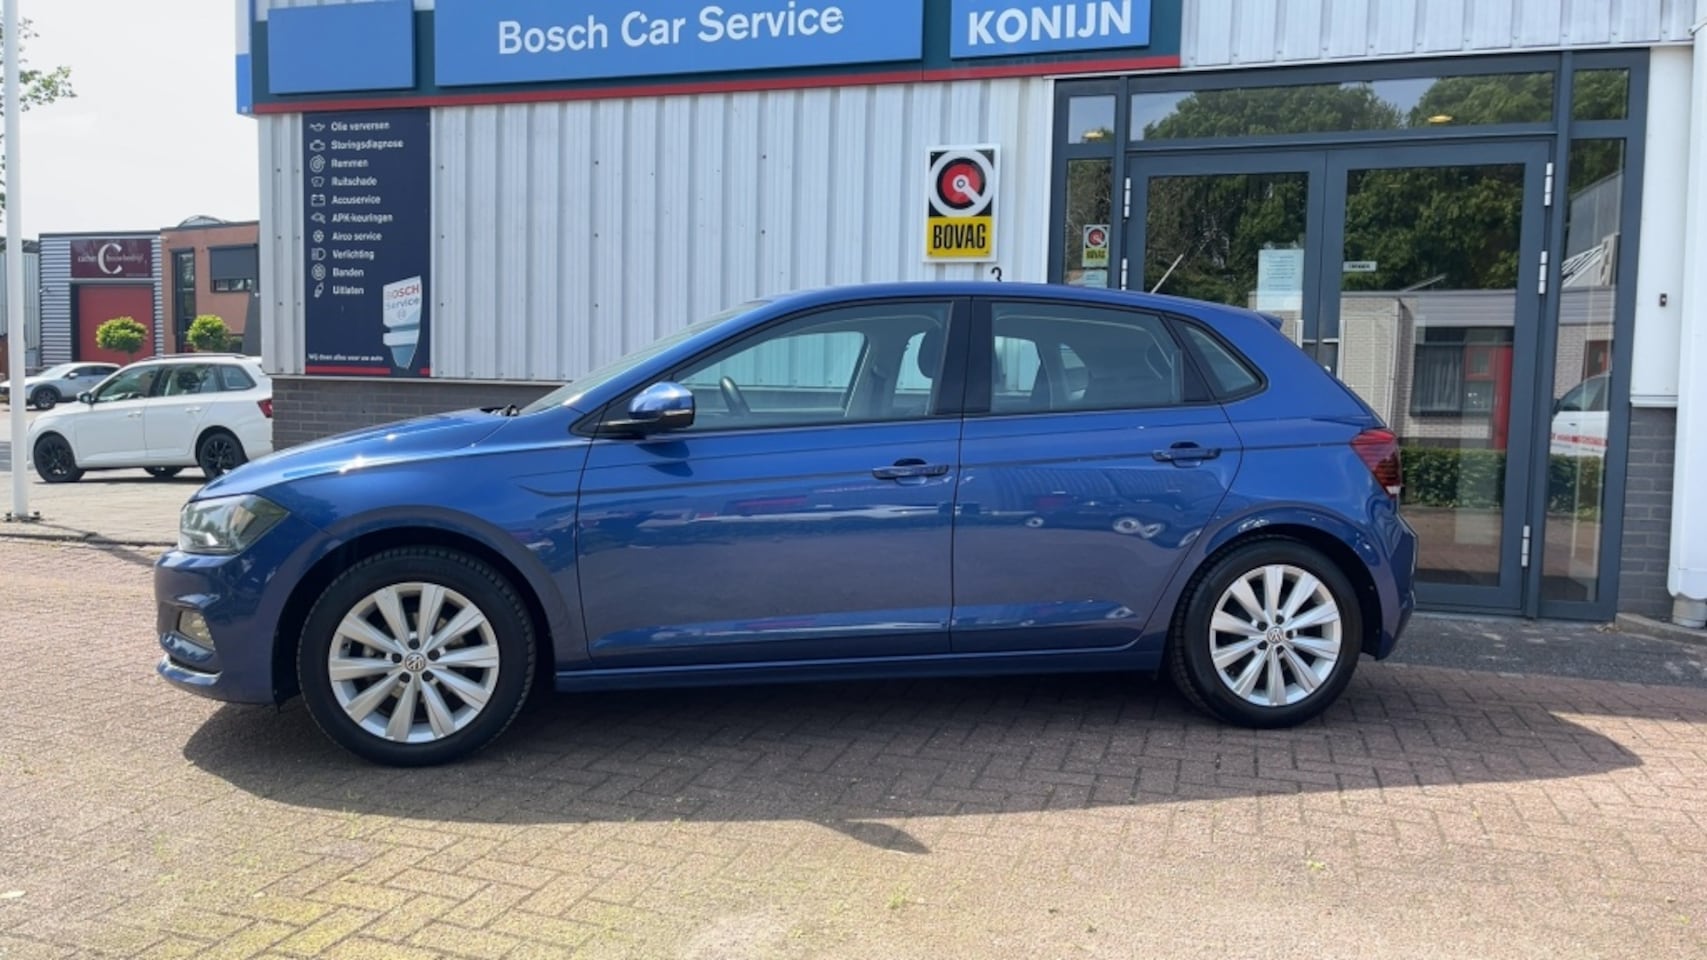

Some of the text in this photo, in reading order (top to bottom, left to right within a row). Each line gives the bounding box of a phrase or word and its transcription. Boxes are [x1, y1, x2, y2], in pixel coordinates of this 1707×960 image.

[499, 1, 843, 54] Bosch Car Service
[968, 0, 1132, 45] KONIJN
[331, 122, 389, 131] Olie verversen
[331, 140, 403, 150] Storingsdiagnose
[331, 159, 368, 168] Remmen
[331, 176, 378, 187] Ruitschade
[331, 195, 381, 205] Accuservice
[332, 231, 382, 241] Airco service
[933, 223, 986, 250] BOVAG
[333, 250, 374, 260] Verlichting
[332, 267, 365, 277] Banden
[332, 285, 365, 295] Uitlaten
